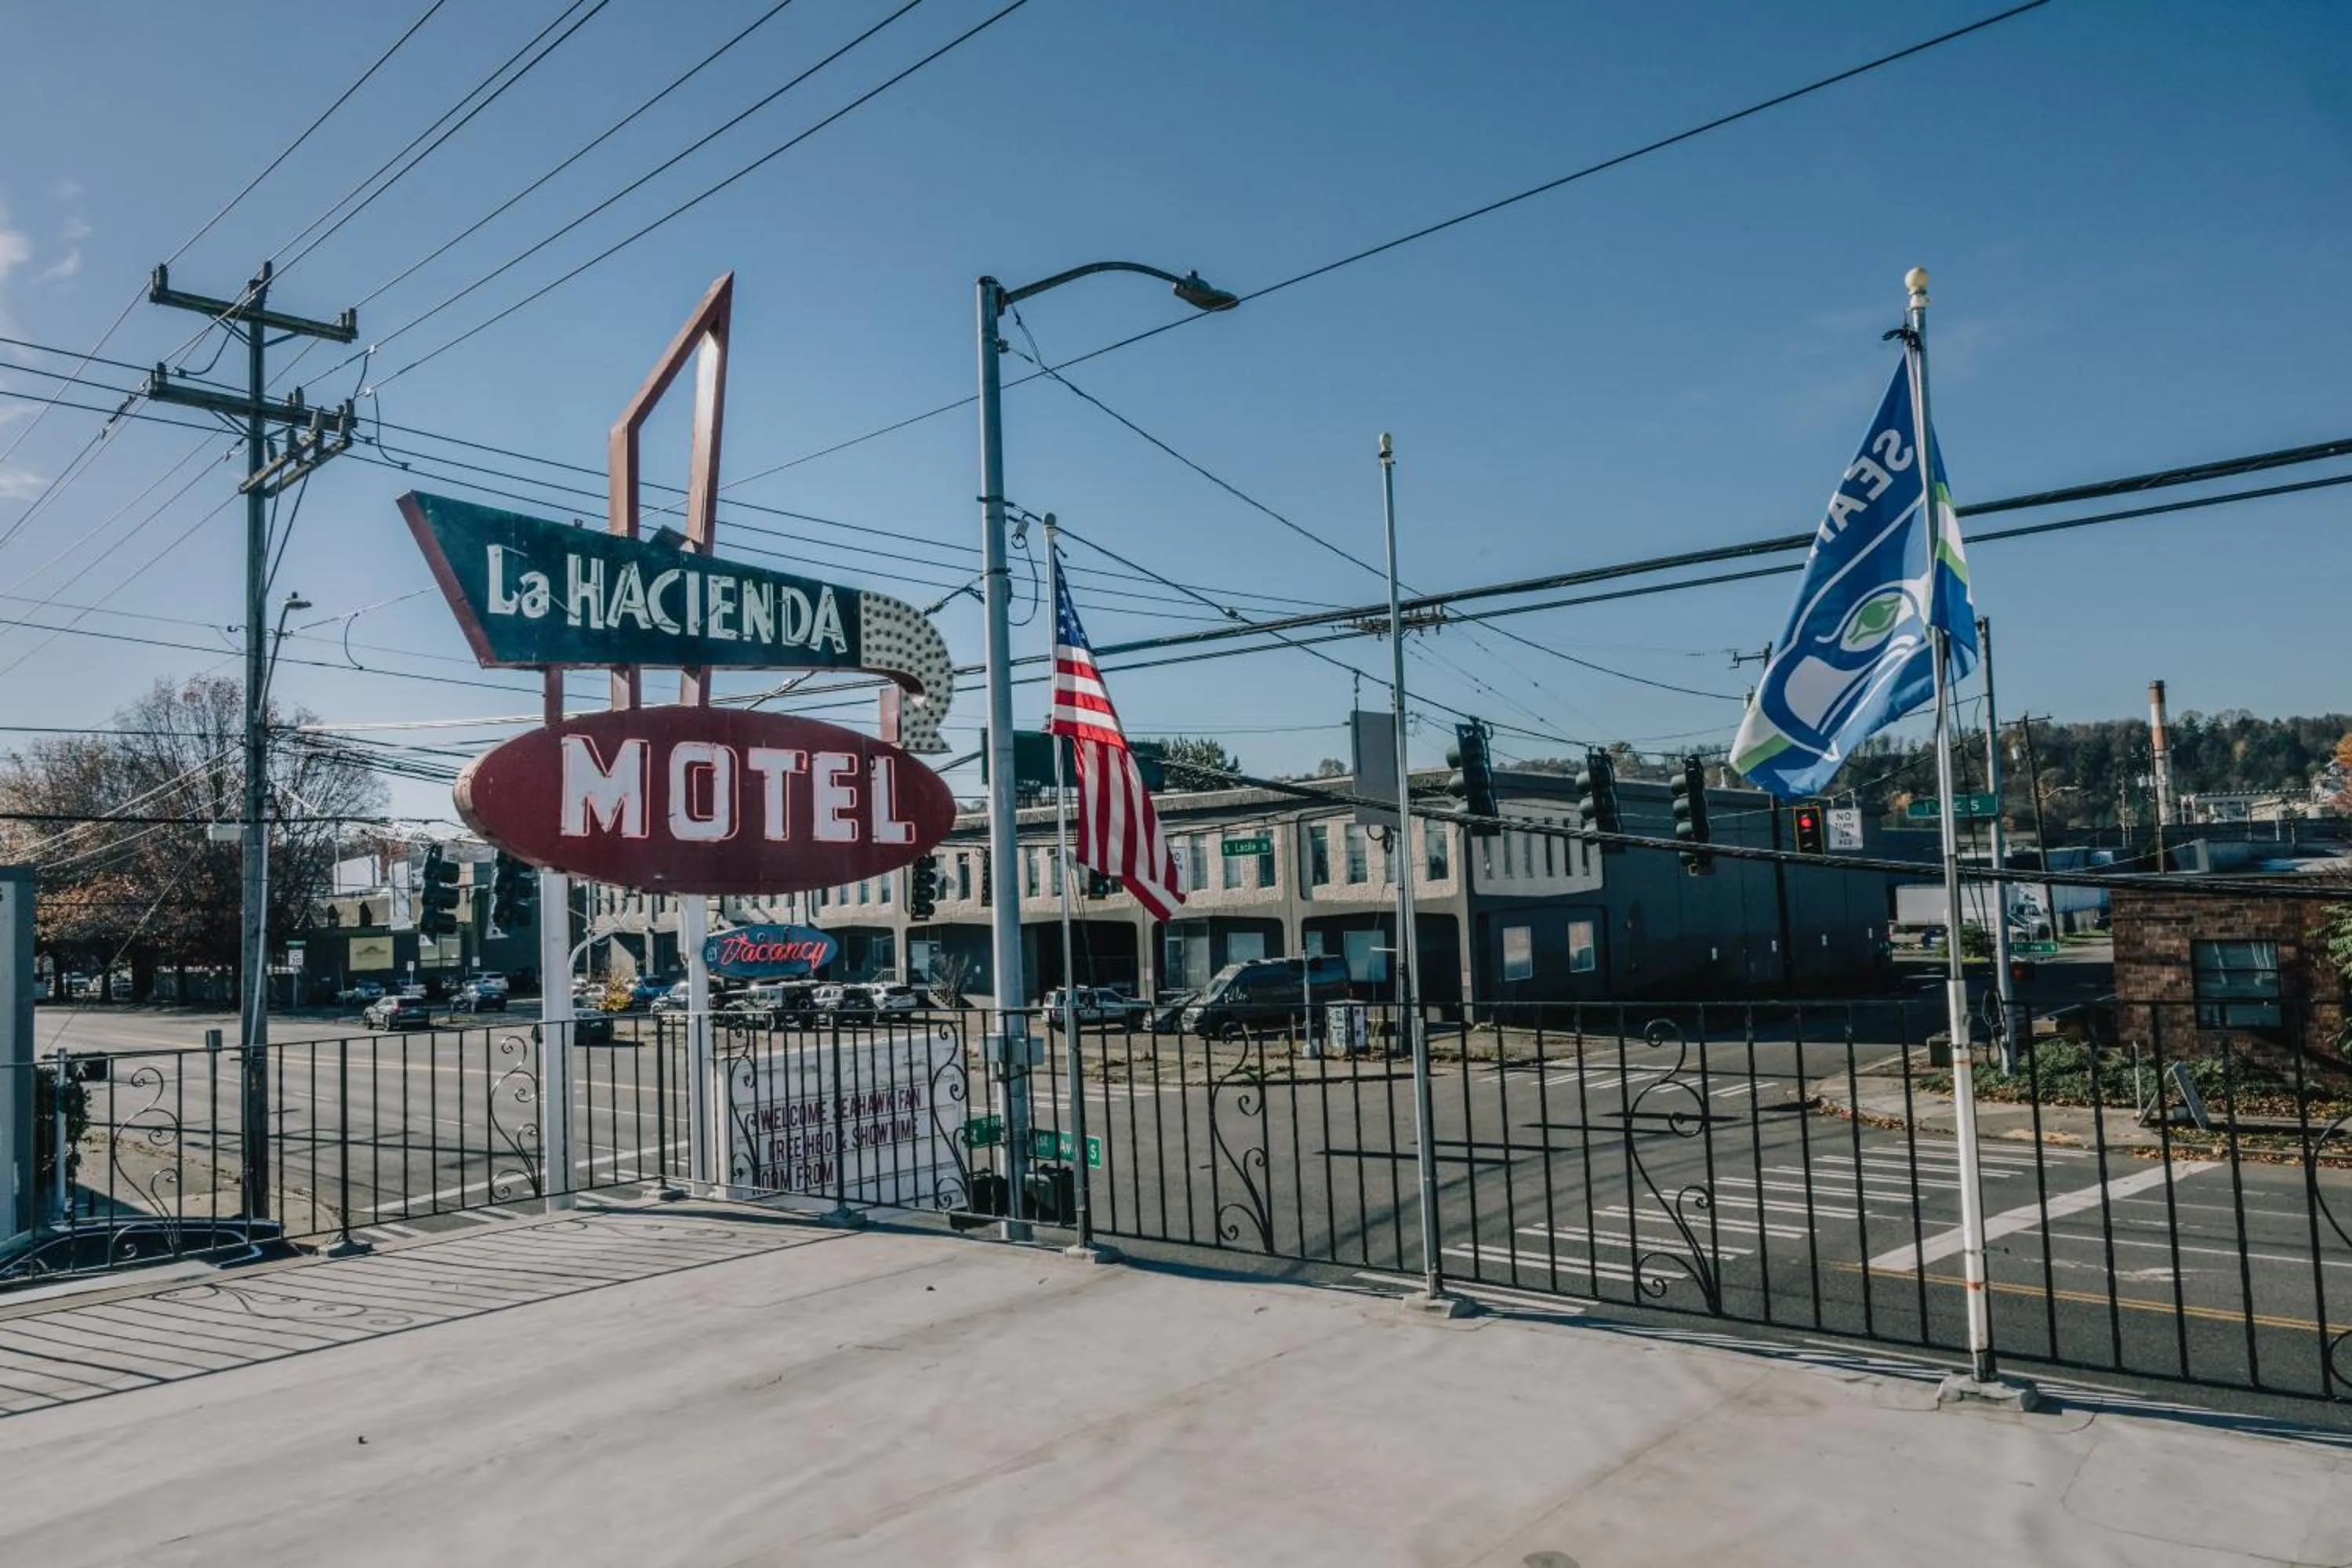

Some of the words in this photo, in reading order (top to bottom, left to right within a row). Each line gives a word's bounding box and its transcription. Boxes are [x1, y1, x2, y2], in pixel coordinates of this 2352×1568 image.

[487, 545, 550, 619] La
[567, 553, 848, 655] HACIENDA
[561, 735, 915, 844] MOTEL
[1835, 811, 1851, 821] NO
[721, 933, 828, 970] Vacancy
[760, 1100, 827, 1131] WELCOME
[807, 1131, 833, 1156] HBO
[1090, 1144, 1098, 1160] S
[797, 1161, 833, 1189] FROM
